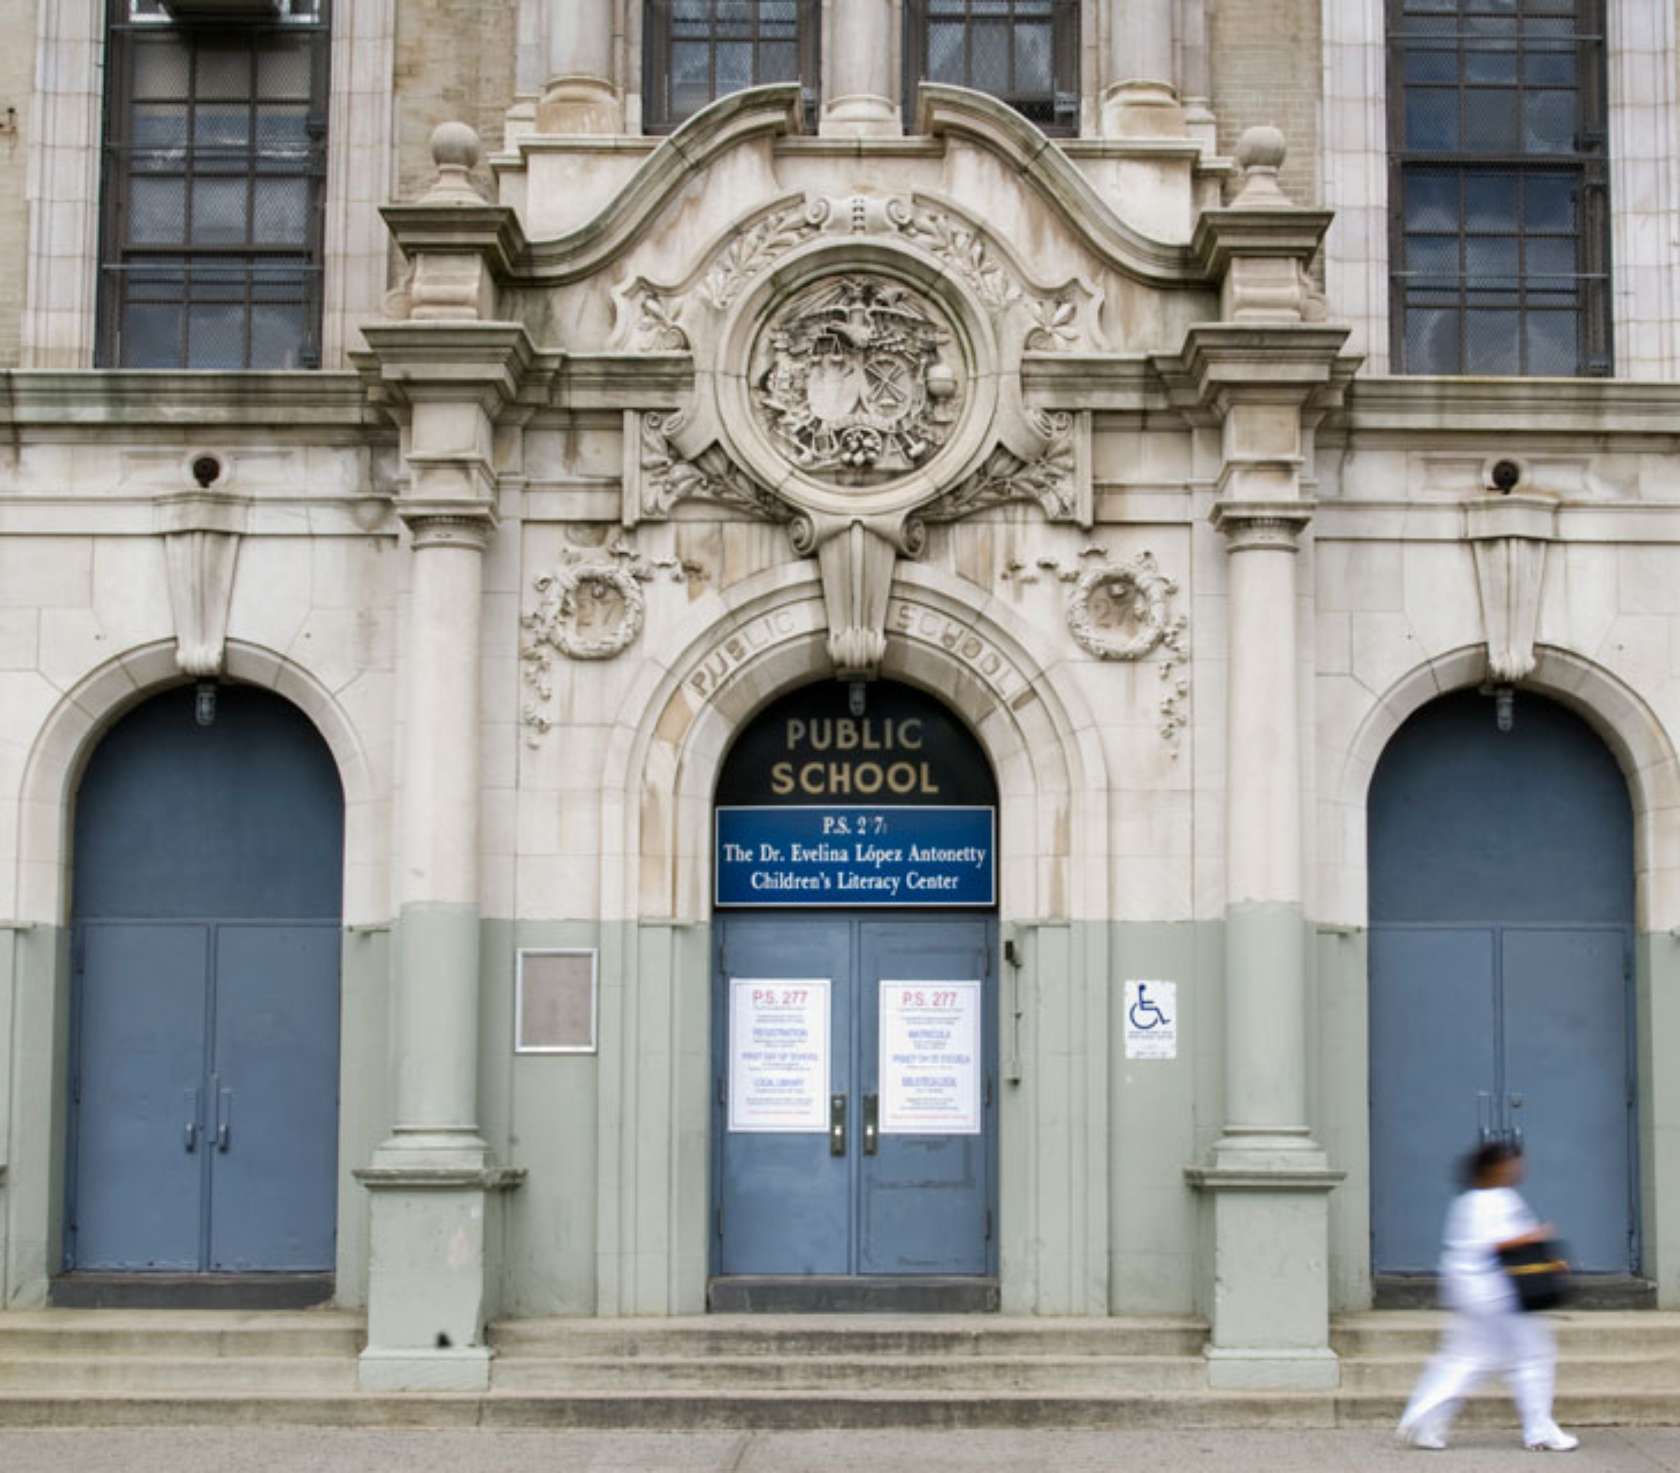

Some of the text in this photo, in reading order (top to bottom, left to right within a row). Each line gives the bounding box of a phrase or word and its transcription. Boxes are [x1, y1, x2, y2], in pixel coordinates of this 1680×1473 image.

[690, 605, 1013, 698] PUBLIC SCHOOL
[786, 718, 923, 750] PUBLIC
[771, 762, 939, 795] SCHOOL
[823, 816, 851, 834] P.S.
[723, 843, 986, 869] The Dr. Evelina López Antonetty
[751, 871, 958, 896] Children's Literacy Center
[782, 990, 808, 1004] 277
[932, 992, 957, 1006] 277
